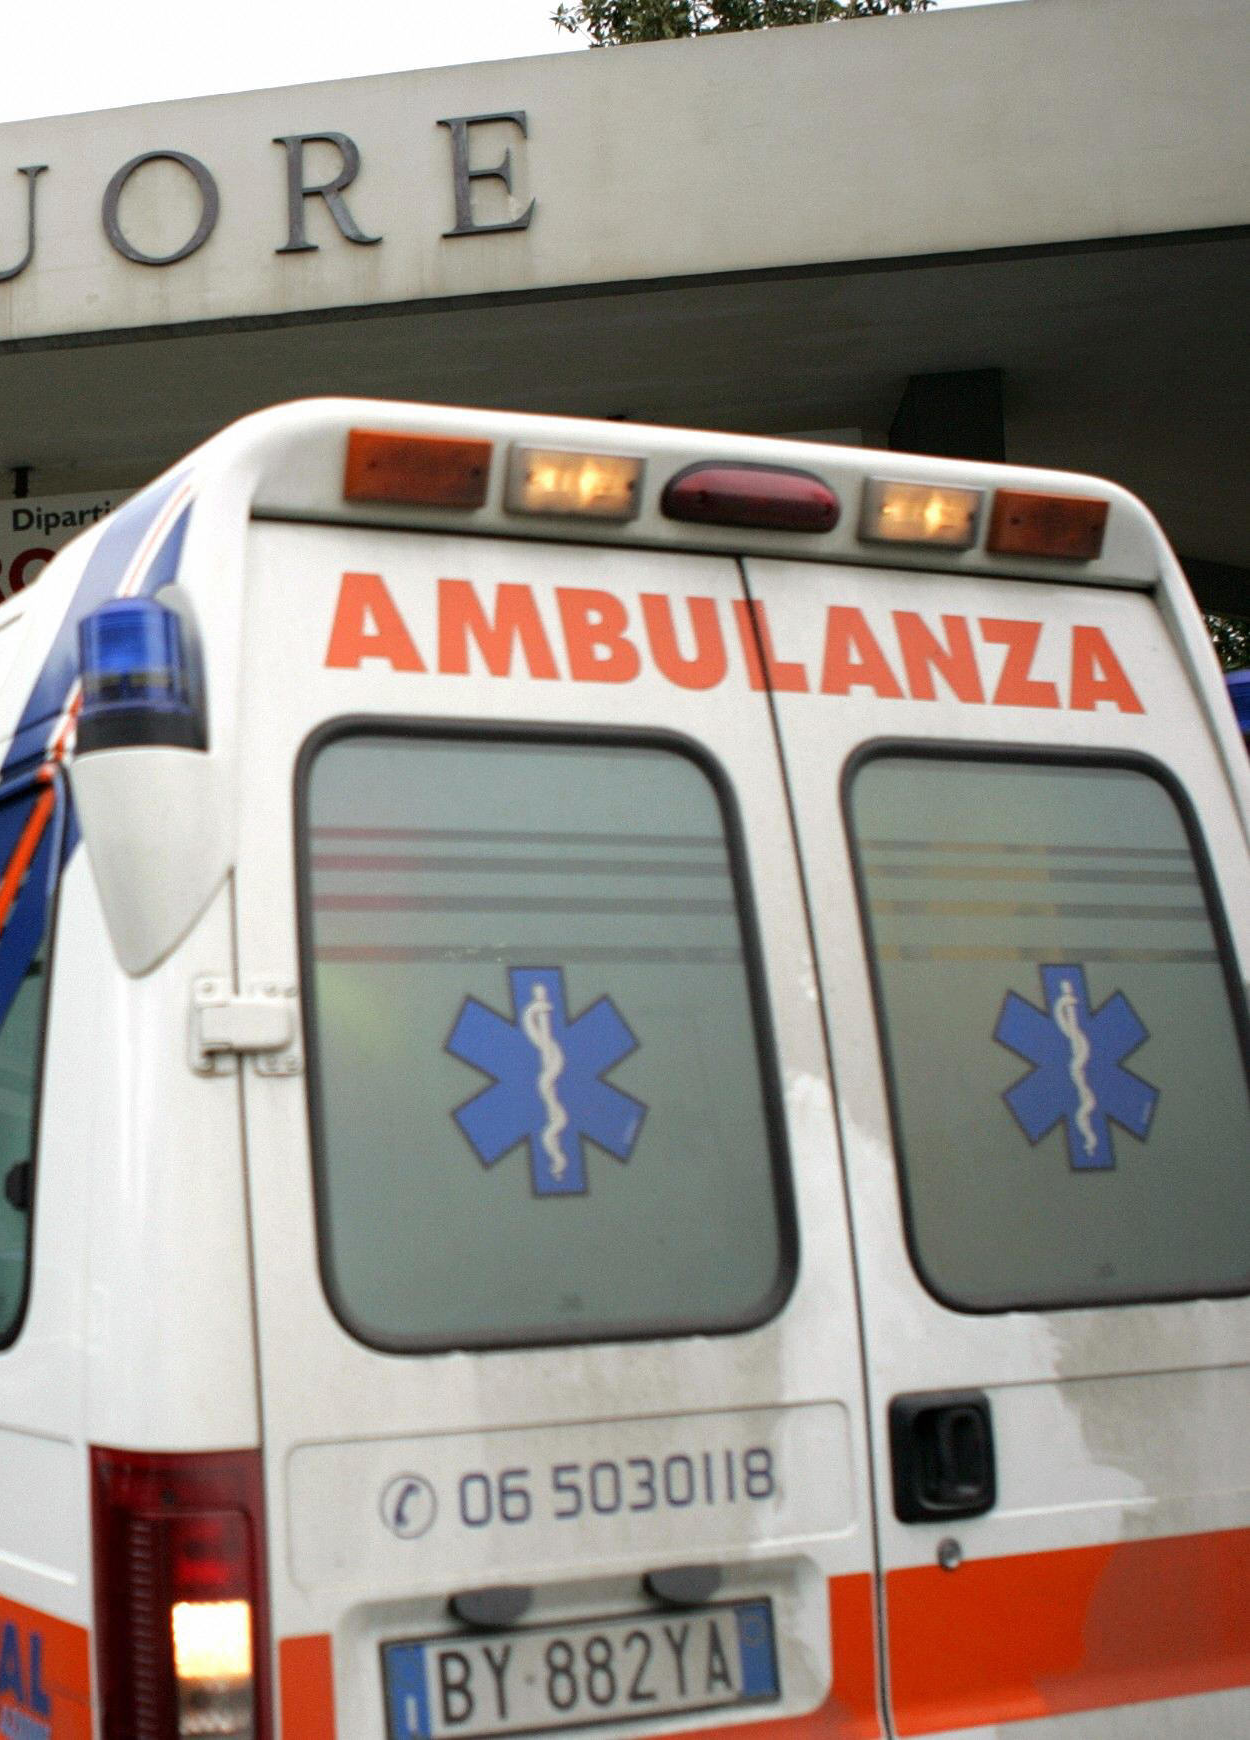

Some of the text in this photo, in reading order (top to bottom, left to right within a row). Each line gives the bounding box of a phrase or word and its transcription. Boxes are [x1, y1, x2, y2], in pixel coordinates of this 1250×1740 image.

[325, 572, 1147, 716] AMBULANZA
[459, 1447, 776, 1529] 06 5030118
[438, 1616, 734, 1728] BY 882YA
